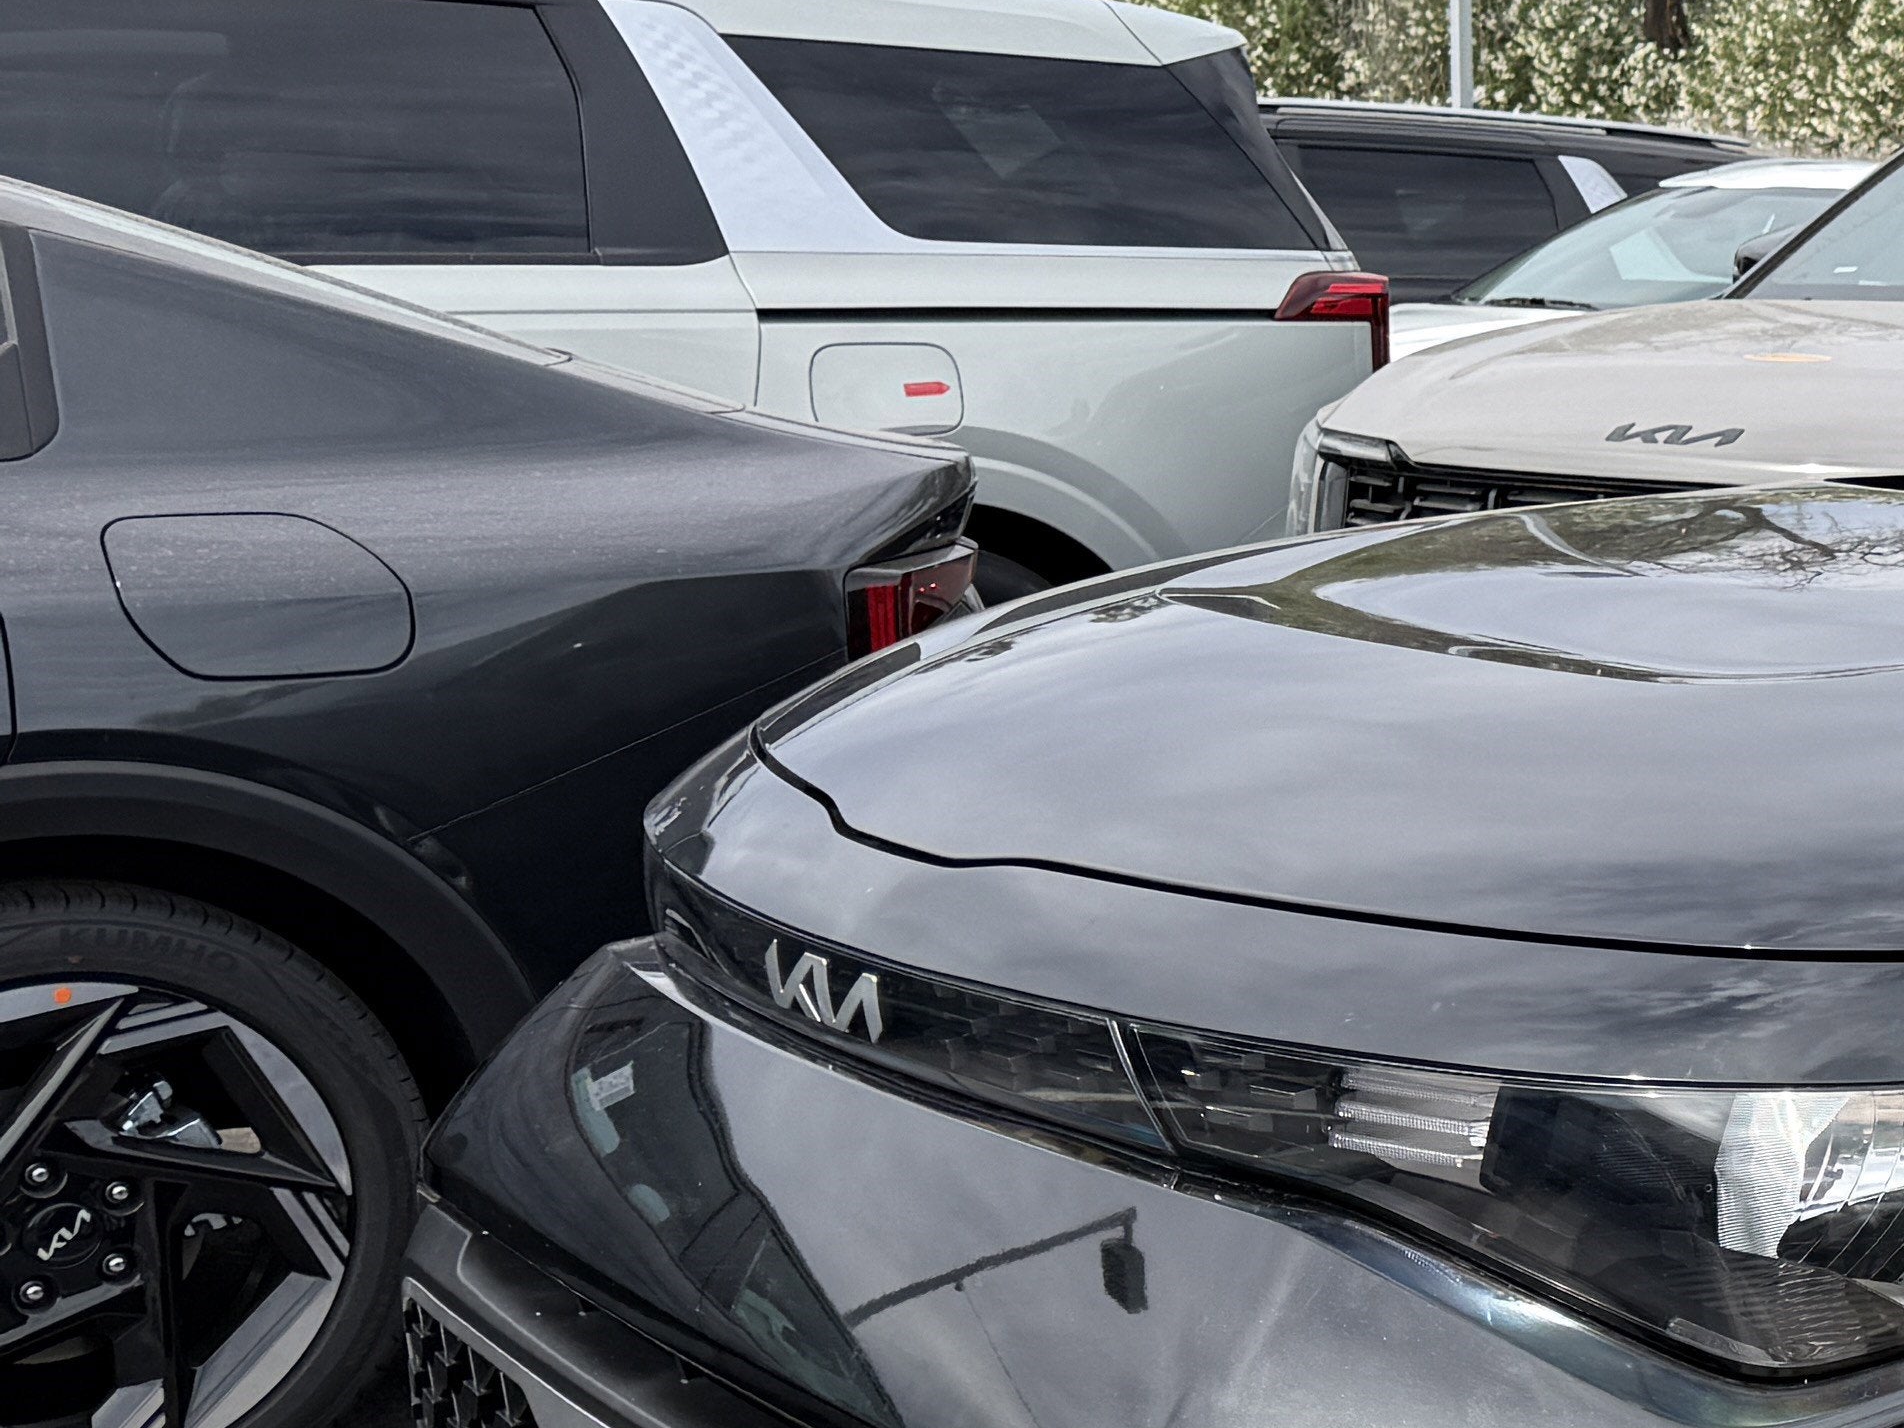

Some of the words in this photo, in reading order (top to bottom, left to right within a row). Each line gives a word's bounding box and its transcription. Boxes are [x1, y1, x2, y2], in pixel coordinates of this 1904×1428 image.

[1605, 422, 1746, 448] KIA
[764, 938, 883, 1044] KIA
[37, 1209, 91, 1261] KIA
